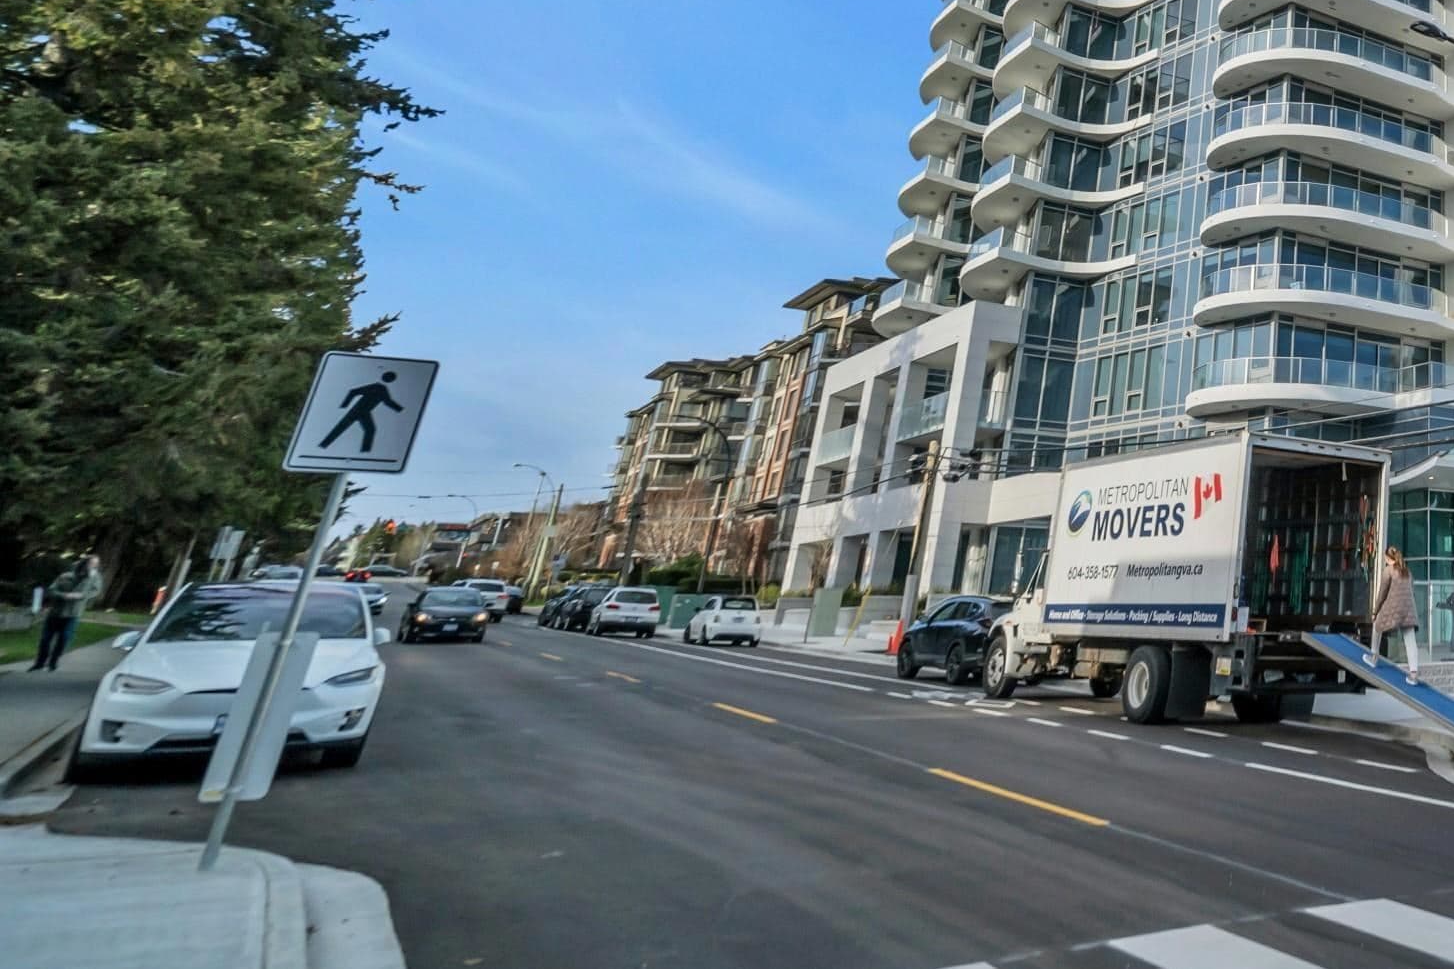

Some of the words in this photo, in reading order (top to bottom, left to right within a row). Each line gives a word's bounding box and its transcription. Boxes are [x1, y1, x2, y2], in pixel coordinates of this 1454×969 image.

[1097, 477, 1189, 506] METROPOLITAN
[1091, 502, 1186, 542] MOVERS
[1067, 564, 1119, 580] 604-358-1577
[1126, 562, 1204, 580] Metropolitangva.ca
[1128, 609, 1149, 624] Packing
[1152, 610, 1175, 624] Supplies
[1178, 610, 1192, 625] Long
[1192, 610, 1218, 623] Distance
